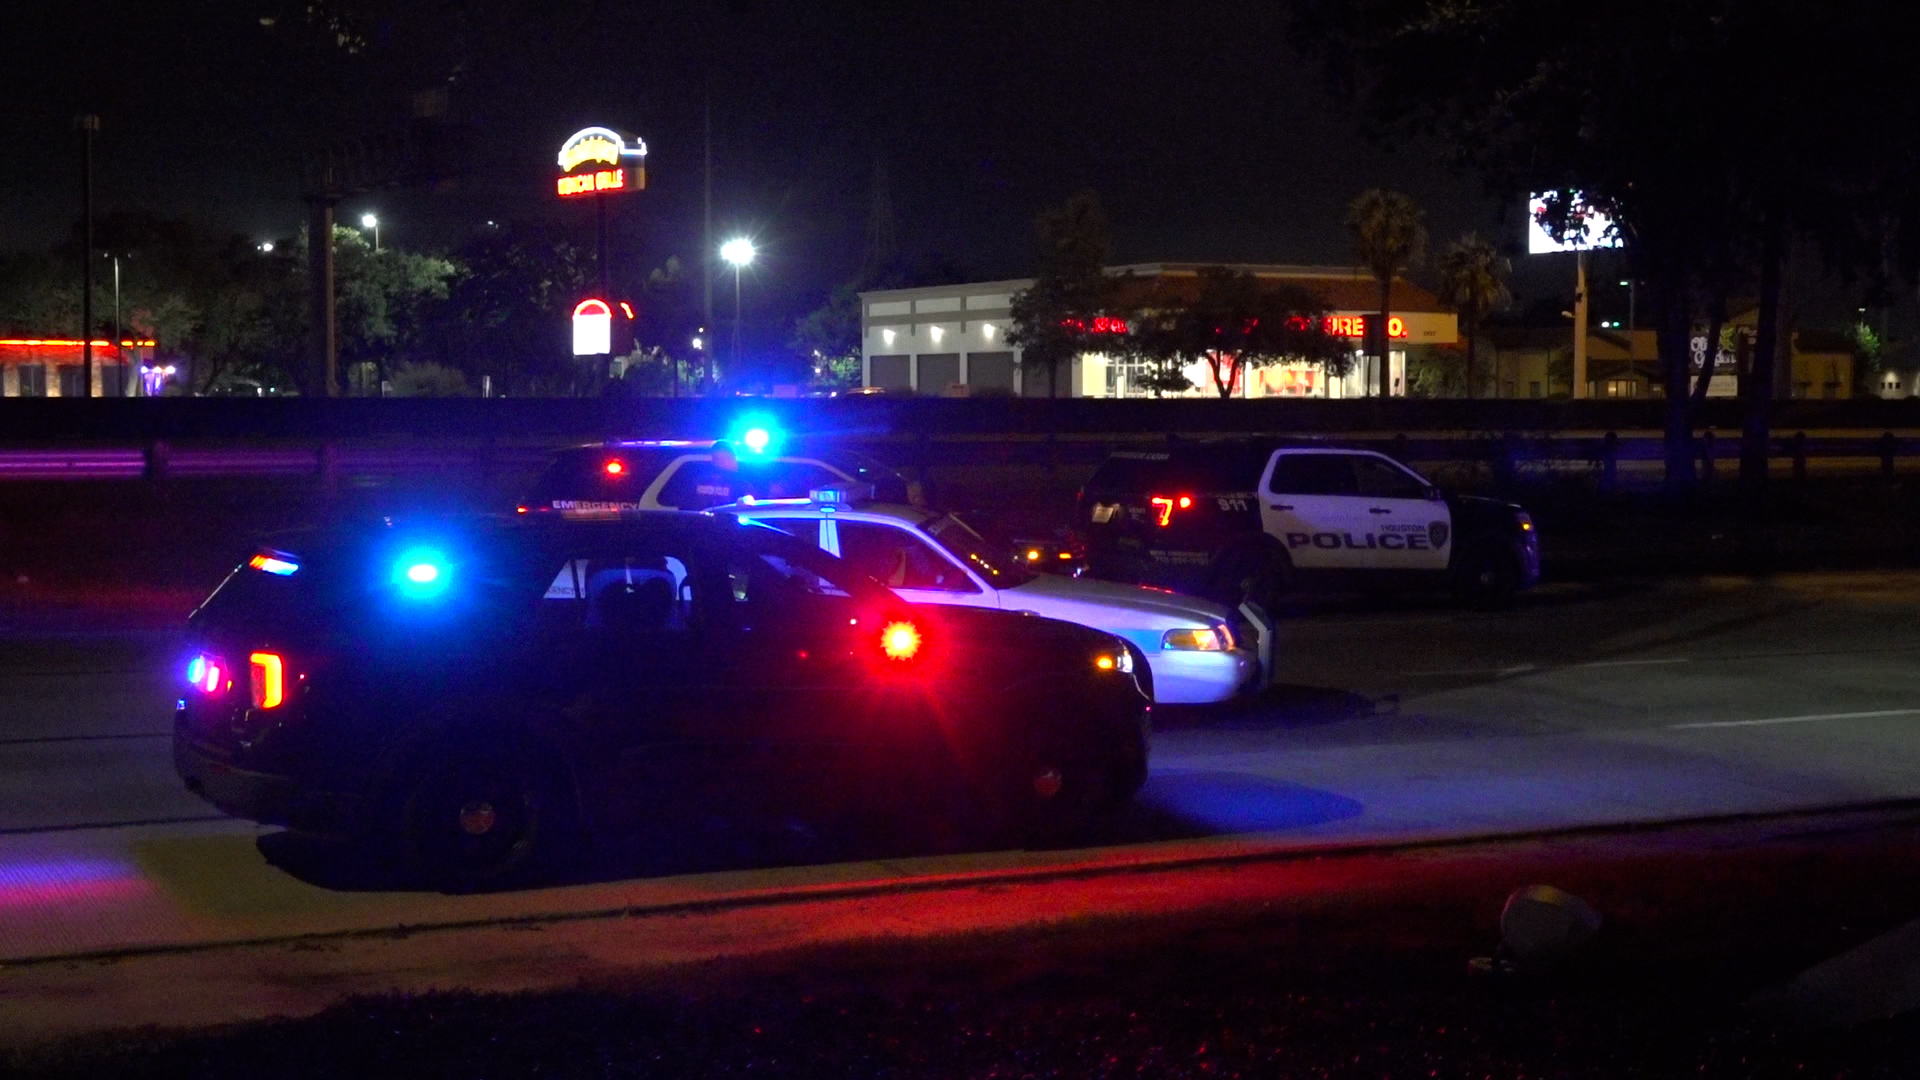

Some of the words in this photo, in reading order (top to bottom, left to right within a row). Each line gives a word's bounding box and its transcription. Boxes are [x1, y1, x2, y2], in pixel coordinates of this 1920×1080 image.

[552, 499, 638, 511] EMERGENCY
[1215, 498, 1247, 512] 911
[1381, 524, 1426, 532] HOUSTON
[1286, 532, 1429, 550] POLICE
